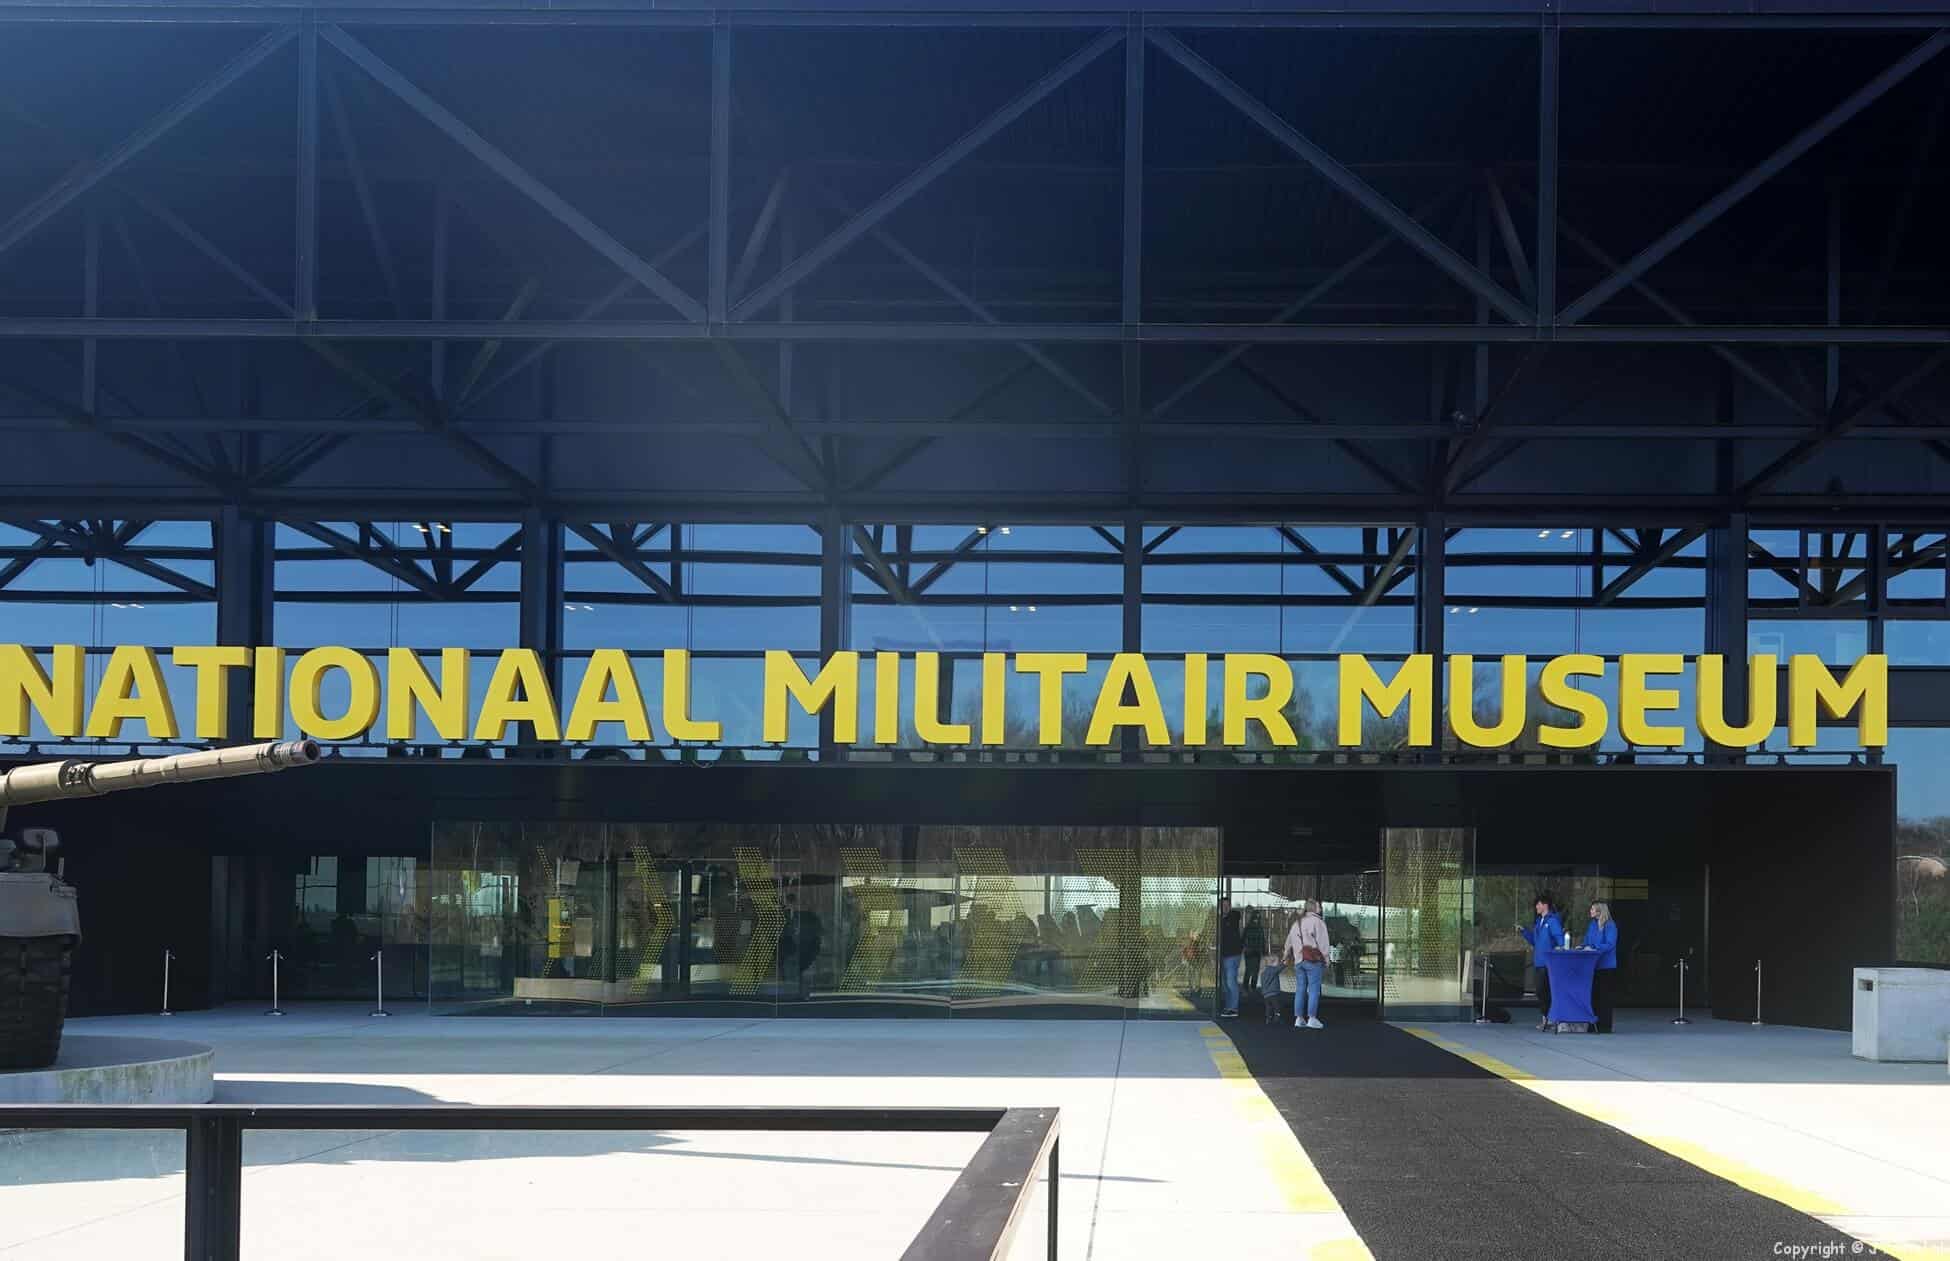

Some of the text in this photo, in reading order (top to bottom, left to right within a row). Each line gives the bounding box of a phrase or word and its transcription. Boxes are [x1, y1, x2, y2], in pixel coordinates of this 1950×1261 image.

[0, 643, 1889, 749] NATIONAAL MILITAIR MUSEUM
